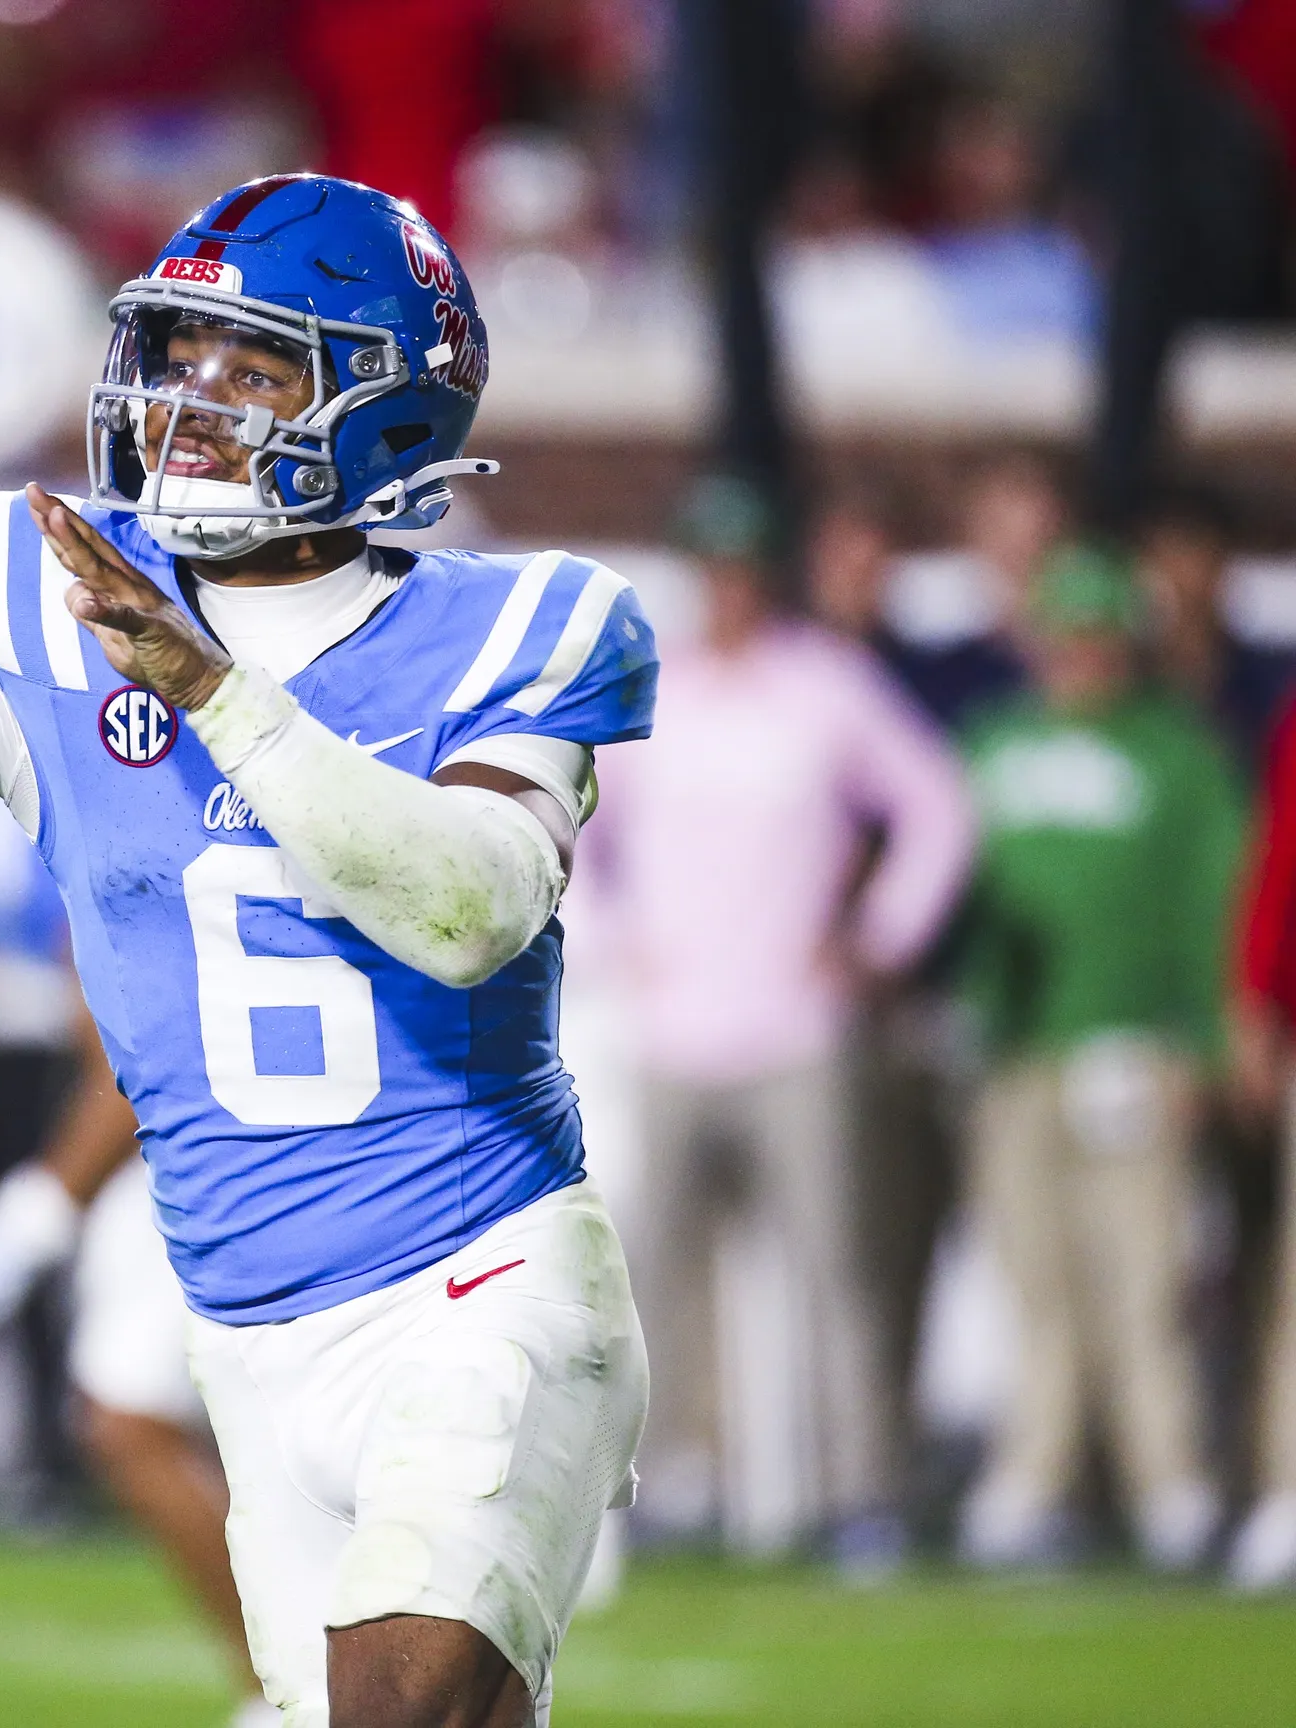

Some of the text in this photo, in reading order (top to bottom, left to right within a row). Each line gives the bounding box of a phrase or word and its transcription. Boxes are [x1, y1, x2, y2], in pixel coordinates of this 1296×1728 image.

[160, 258, 224, 284] REBS
[105, 691, 168, 761] SEC
[182, 843, 381, 1126] 6
